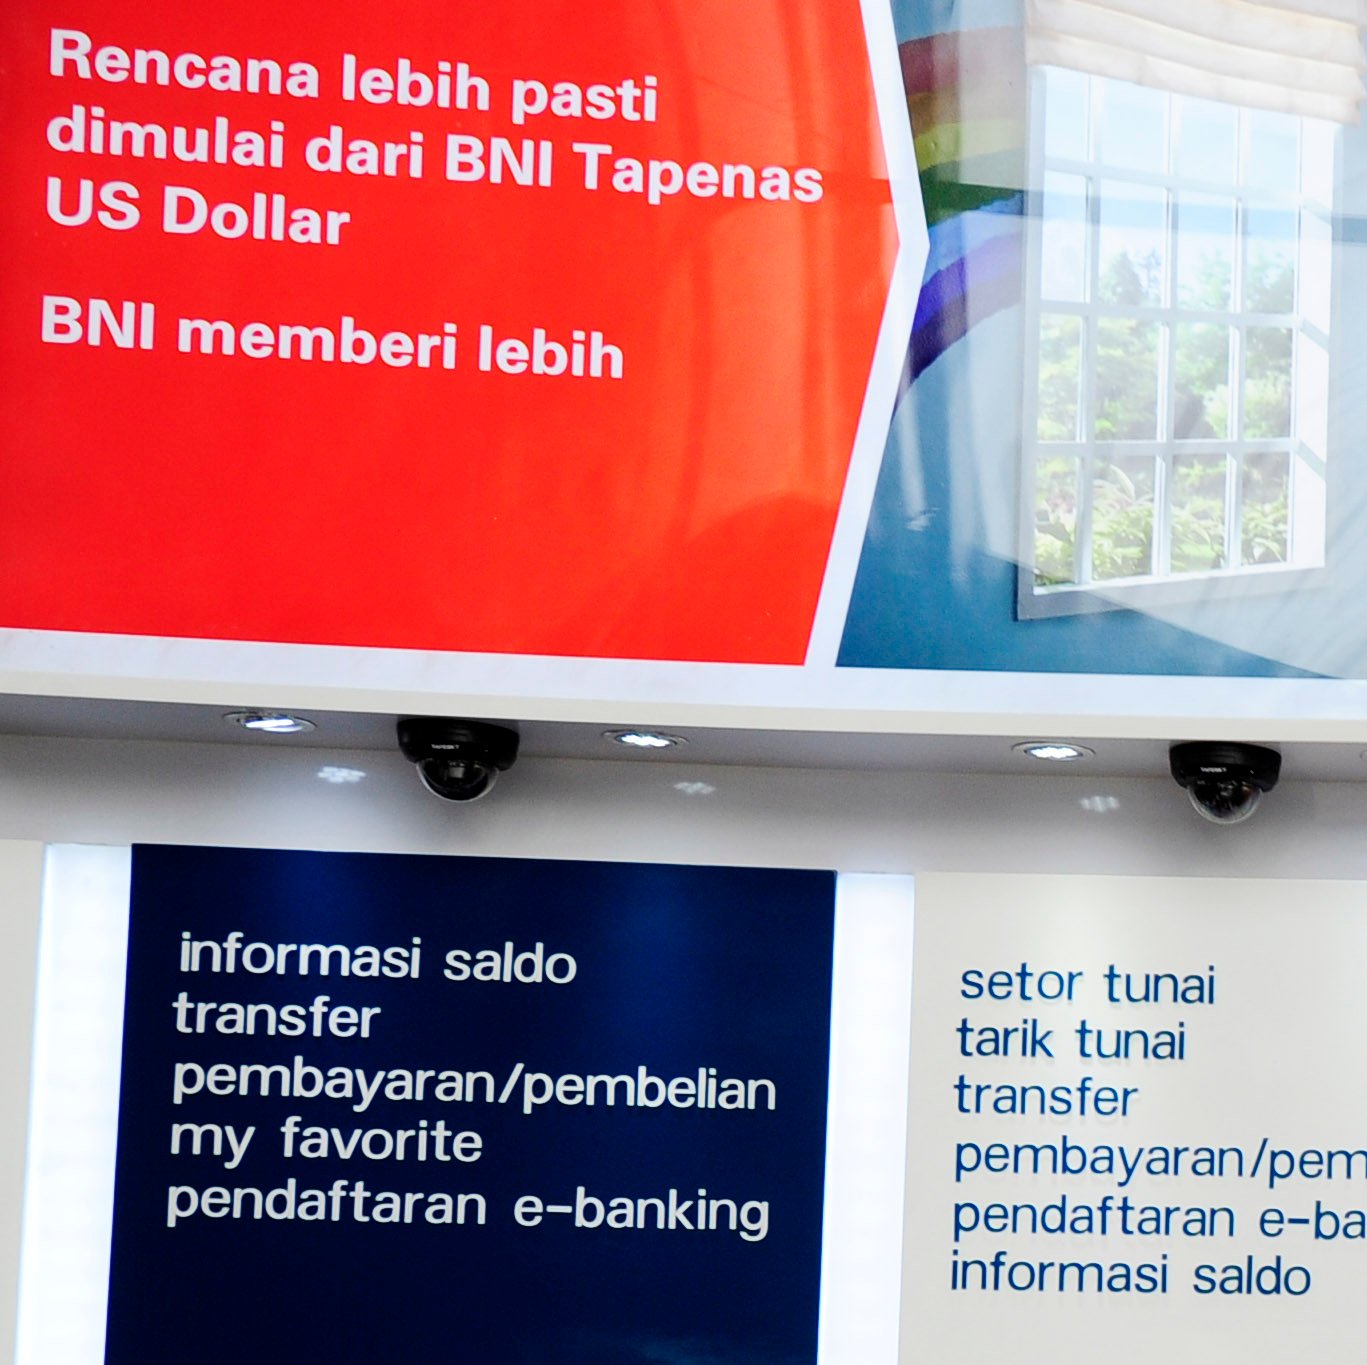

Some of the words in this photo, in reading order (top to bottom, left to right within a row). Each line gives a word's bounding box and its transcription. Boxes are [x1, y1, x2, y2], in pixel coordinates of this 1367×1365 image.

[48, 27, 320, 98] Rencana
[342, 55, 490, 111] lebih
[511, 75, 659, 124] pasti
[46, 105, 285, 169] dimulai
[305, 129, 423, 179] dari
[446, 135, 553, 187] BNI
[573, 141, 824, 205] Tapenas
[46, 176, 141, 231] US
[162, 185, 351, 245] Dollar
[41, 295, 155, 351] BNI
[177, 317, 457, 370] memberi
[478, 326, 625, 379] lebih
[180, 931, 422, 979] informasi
[443, 942, 578, 984] saldo
[960, 962, 1083, 1001] setor
[1103, 964, 1216, 1004] tunai
[172, 992, 381, 1039] transfer
[956, 1017, 1054, 1058] tarik
[1075, 1019, 1185, 1060] tunai
[173, 1055, 777, 1114] pembayaran/pembelian
[953, 1075, 1139, 1116] transfer
[170, 1122, 255, 1169] my
[280, 1116, 484, 1162] favorite
[166, 1178, 487, 1228] pendaftaran
[513, 1187, 770, 1242] e-banking
[953, 1194, 1235, 1241] pendaftaran
[951, 1250, 1168, 1292] informasi
[1193, 1255, 1312, 1296] saldo
